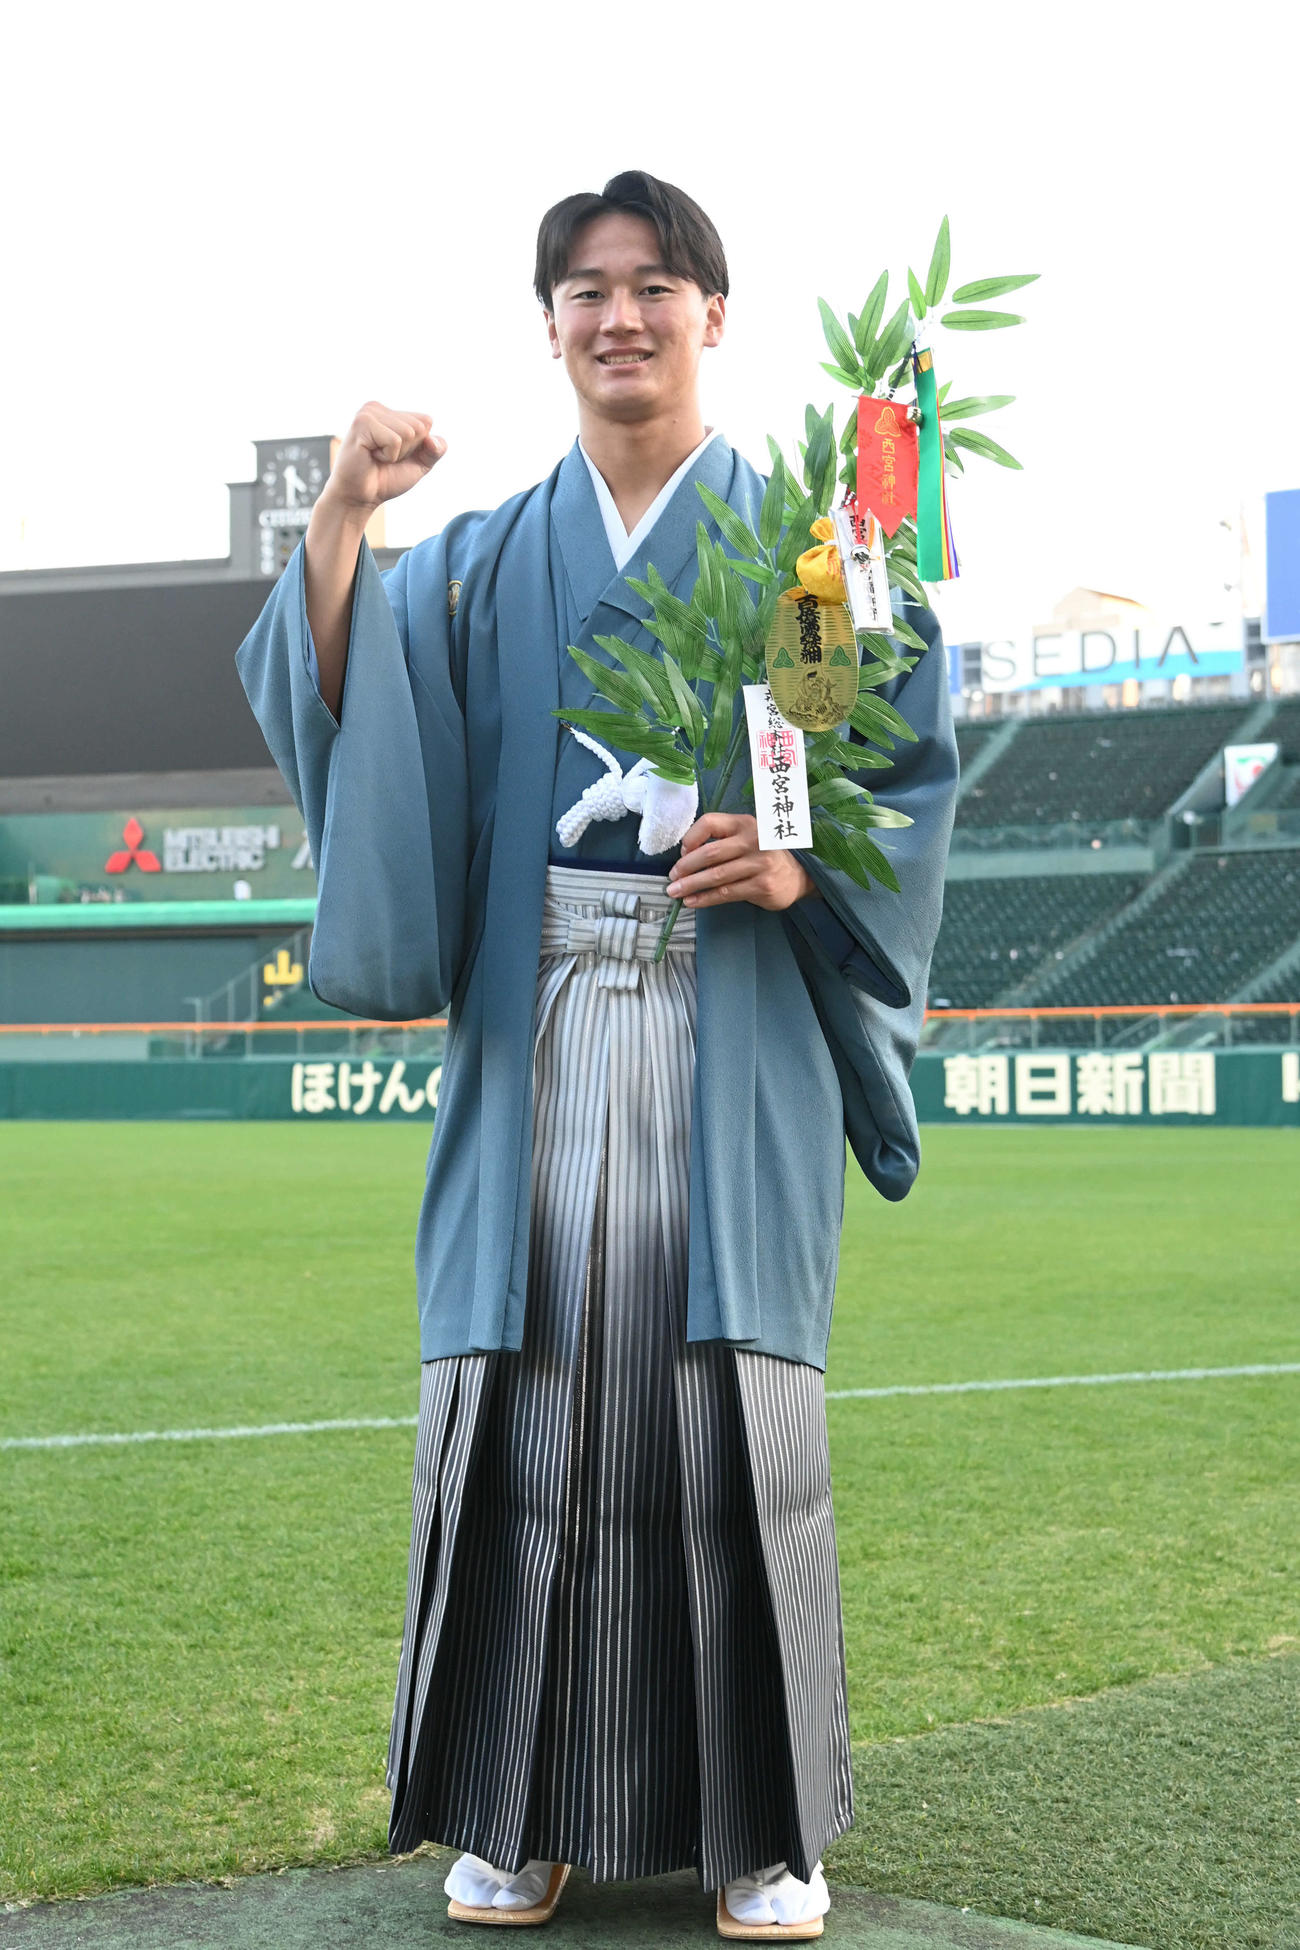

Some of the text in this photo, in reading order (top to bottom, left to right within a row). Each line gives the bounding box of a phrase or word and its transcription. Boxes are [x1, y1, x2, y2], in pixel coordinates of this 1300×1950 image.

[881, 438, 896, 506] 西宮神社
[982, 626, 1199, 681] SEDIA
[944, 1051, 1216, 1115] 朝日新聞
